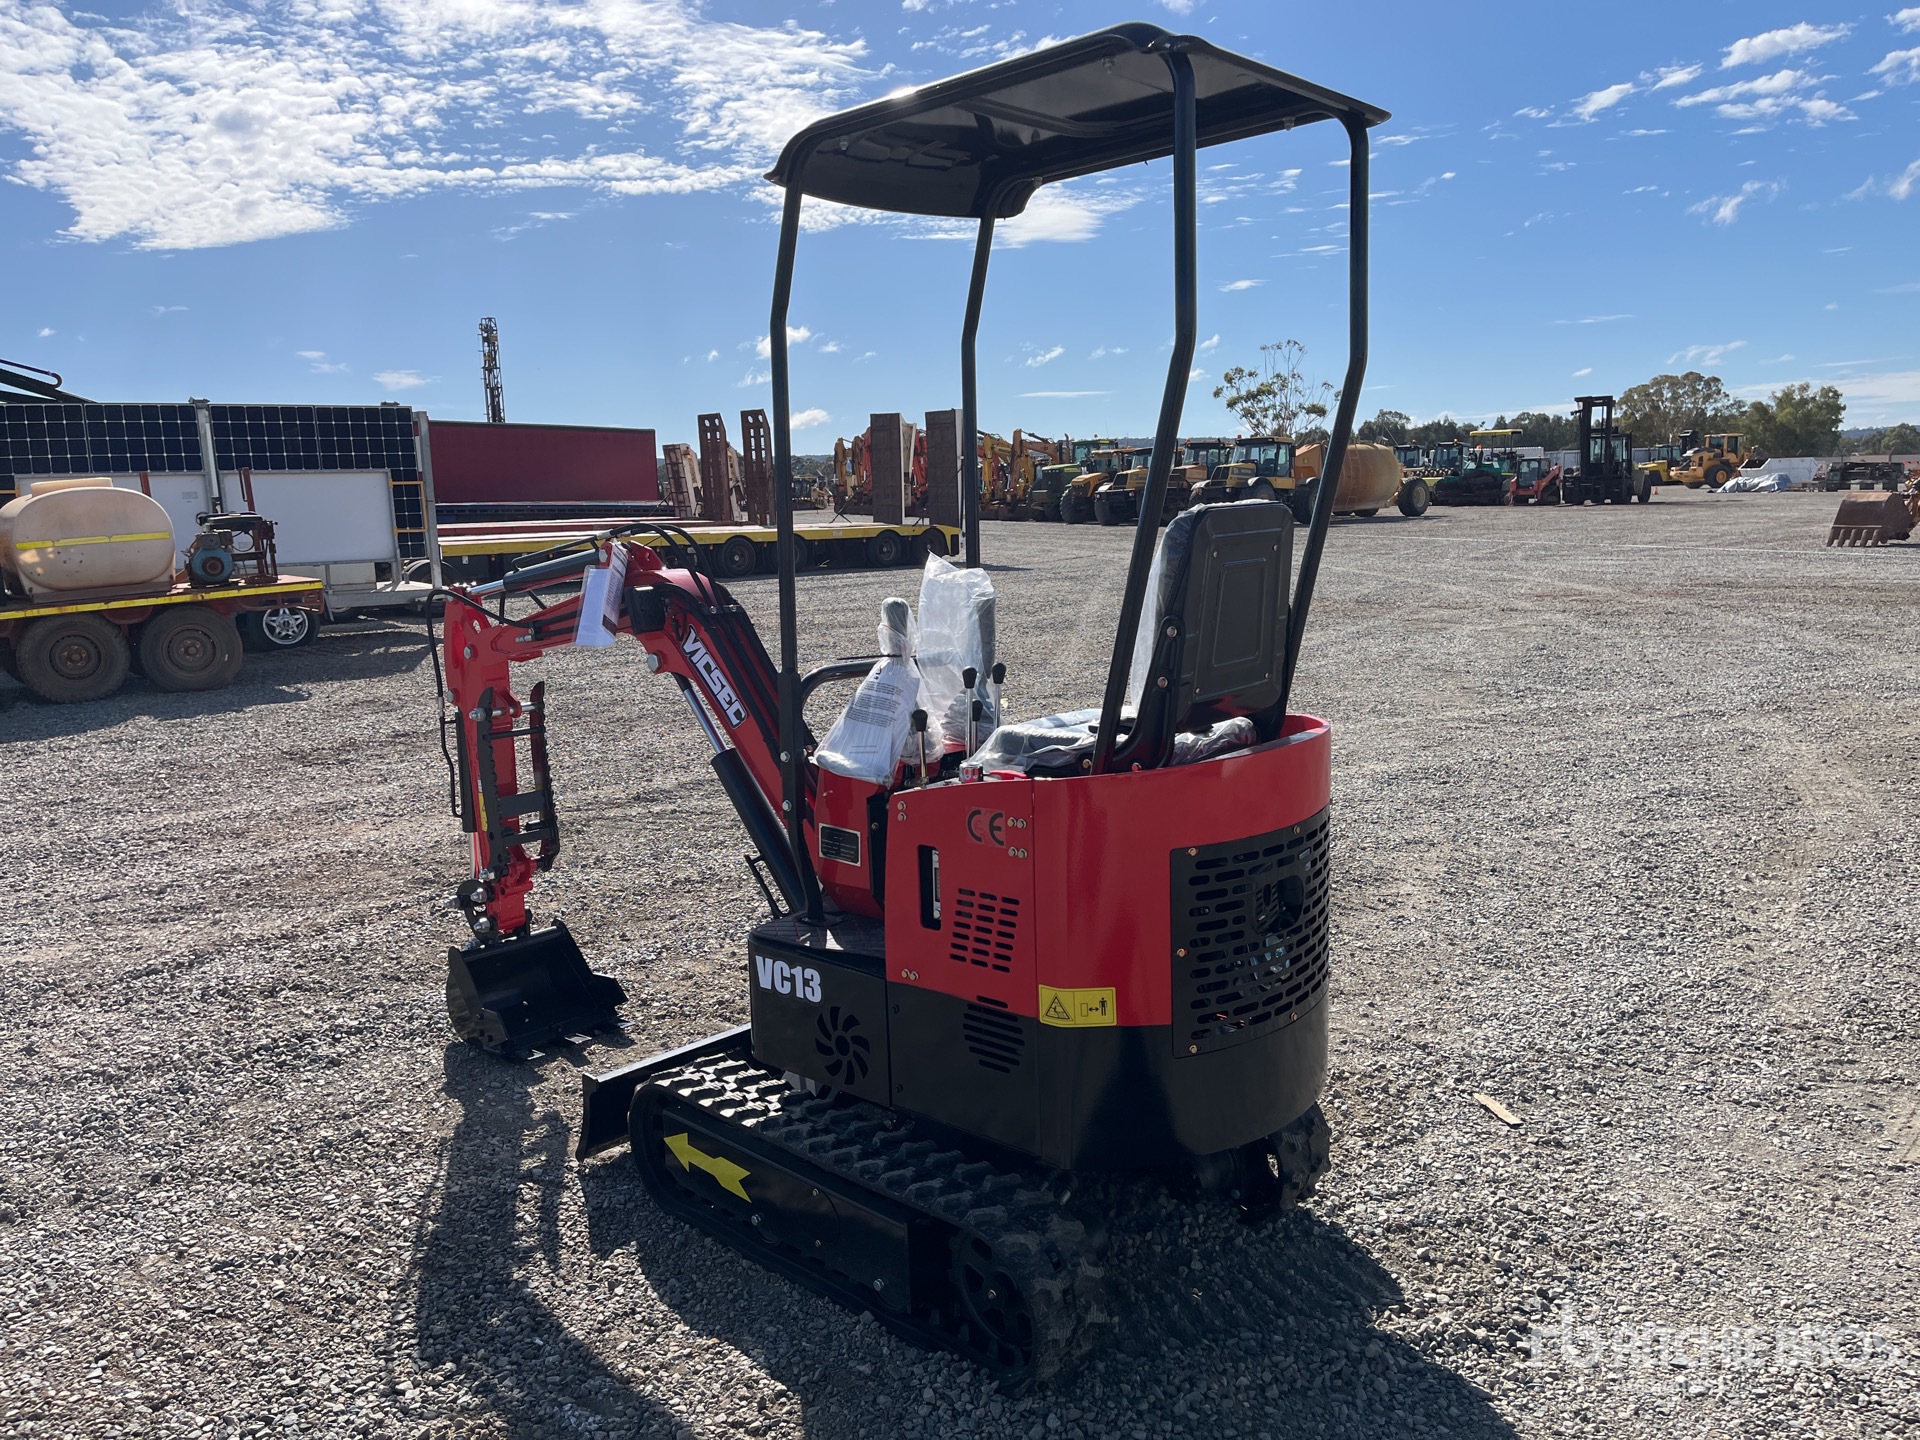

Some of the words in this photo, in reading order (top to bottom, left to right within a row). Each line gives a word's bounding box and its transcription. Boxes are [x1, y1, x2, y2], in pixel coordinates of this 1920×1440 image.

[683, 625, 746, 727] VICSEC
[967, 809, 1005, 846] CE
[755, 955, 822, 1003] VC13
